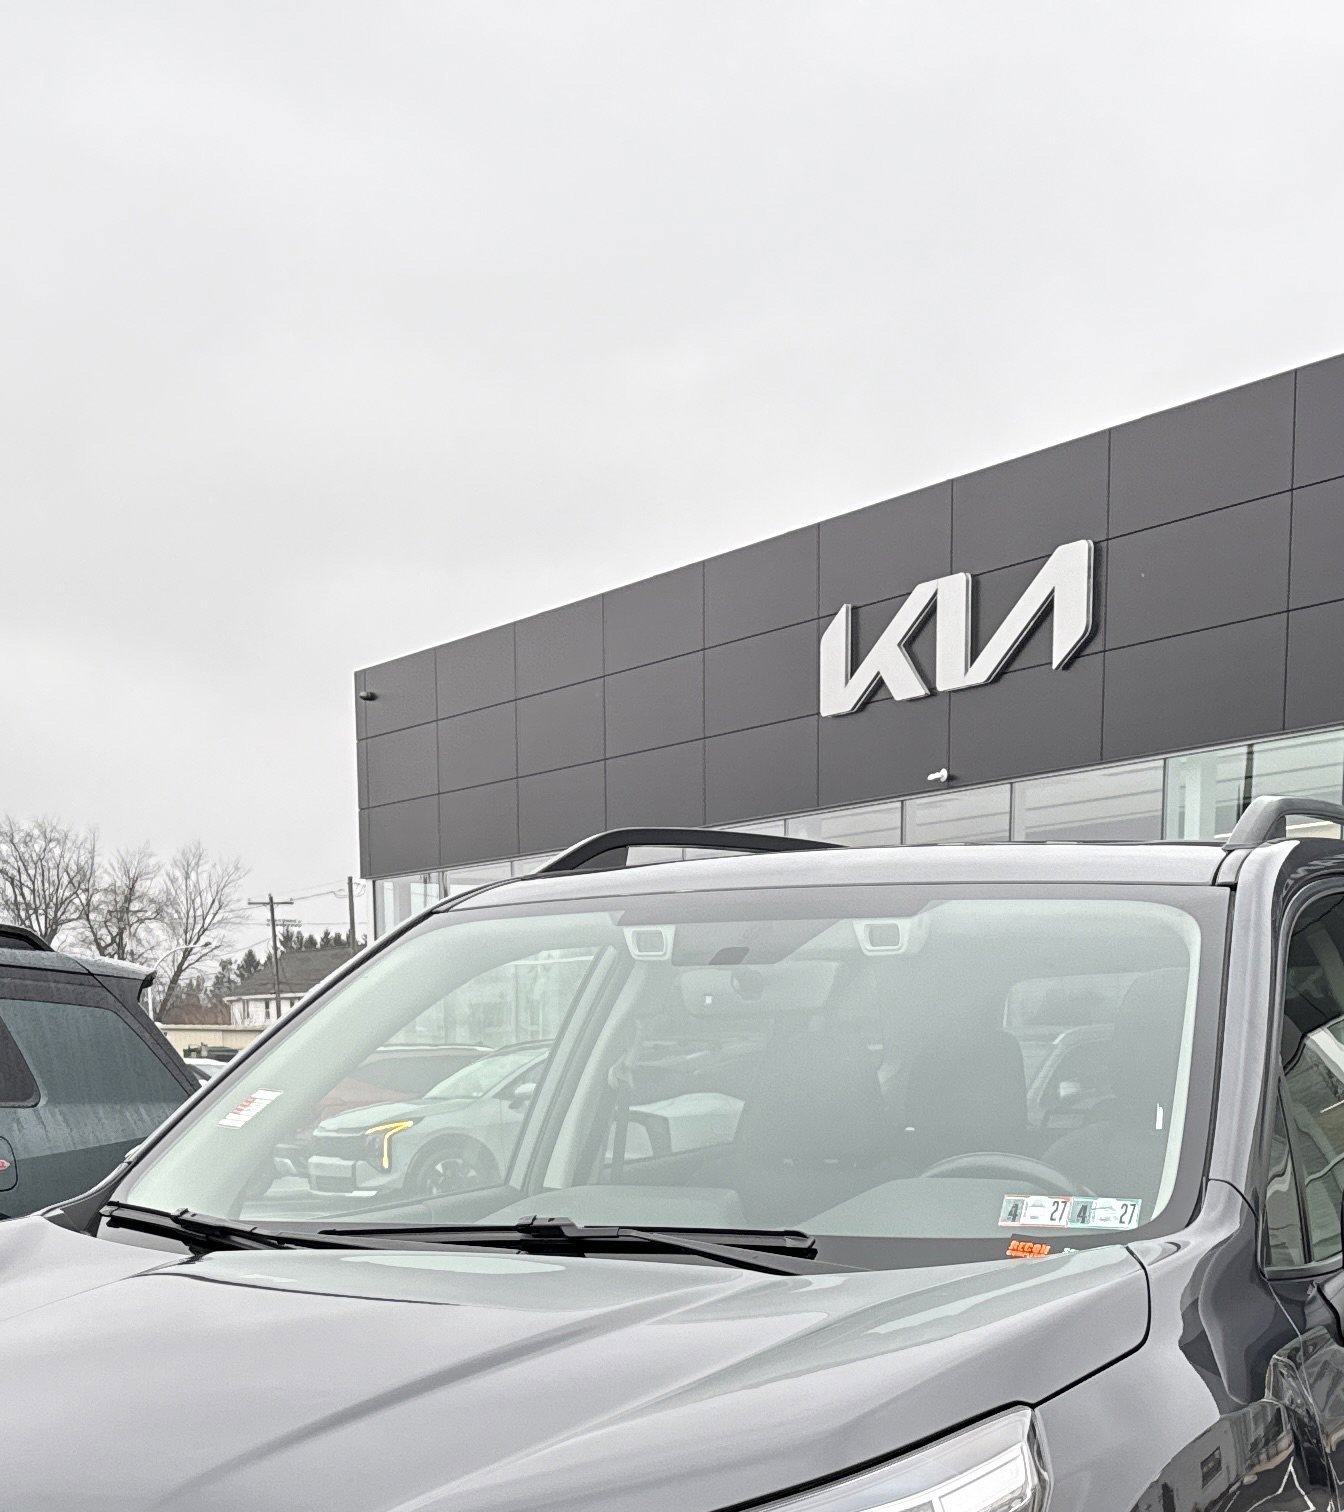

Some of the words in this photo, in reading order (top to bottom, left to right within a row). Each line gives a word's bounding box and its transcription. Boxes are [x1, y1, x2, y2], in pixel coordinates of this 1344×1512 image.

[819, 539, 1095, 718] KIA
[1007, 1203, 1019, 1223] 4
[1049, 1200, 1068, 1222] 27
[1076, 1204, 1089, 1224] 4
[1118, 1203, 1137, 1225] 27
[1008, 1240, 1051, 1255] RECON
